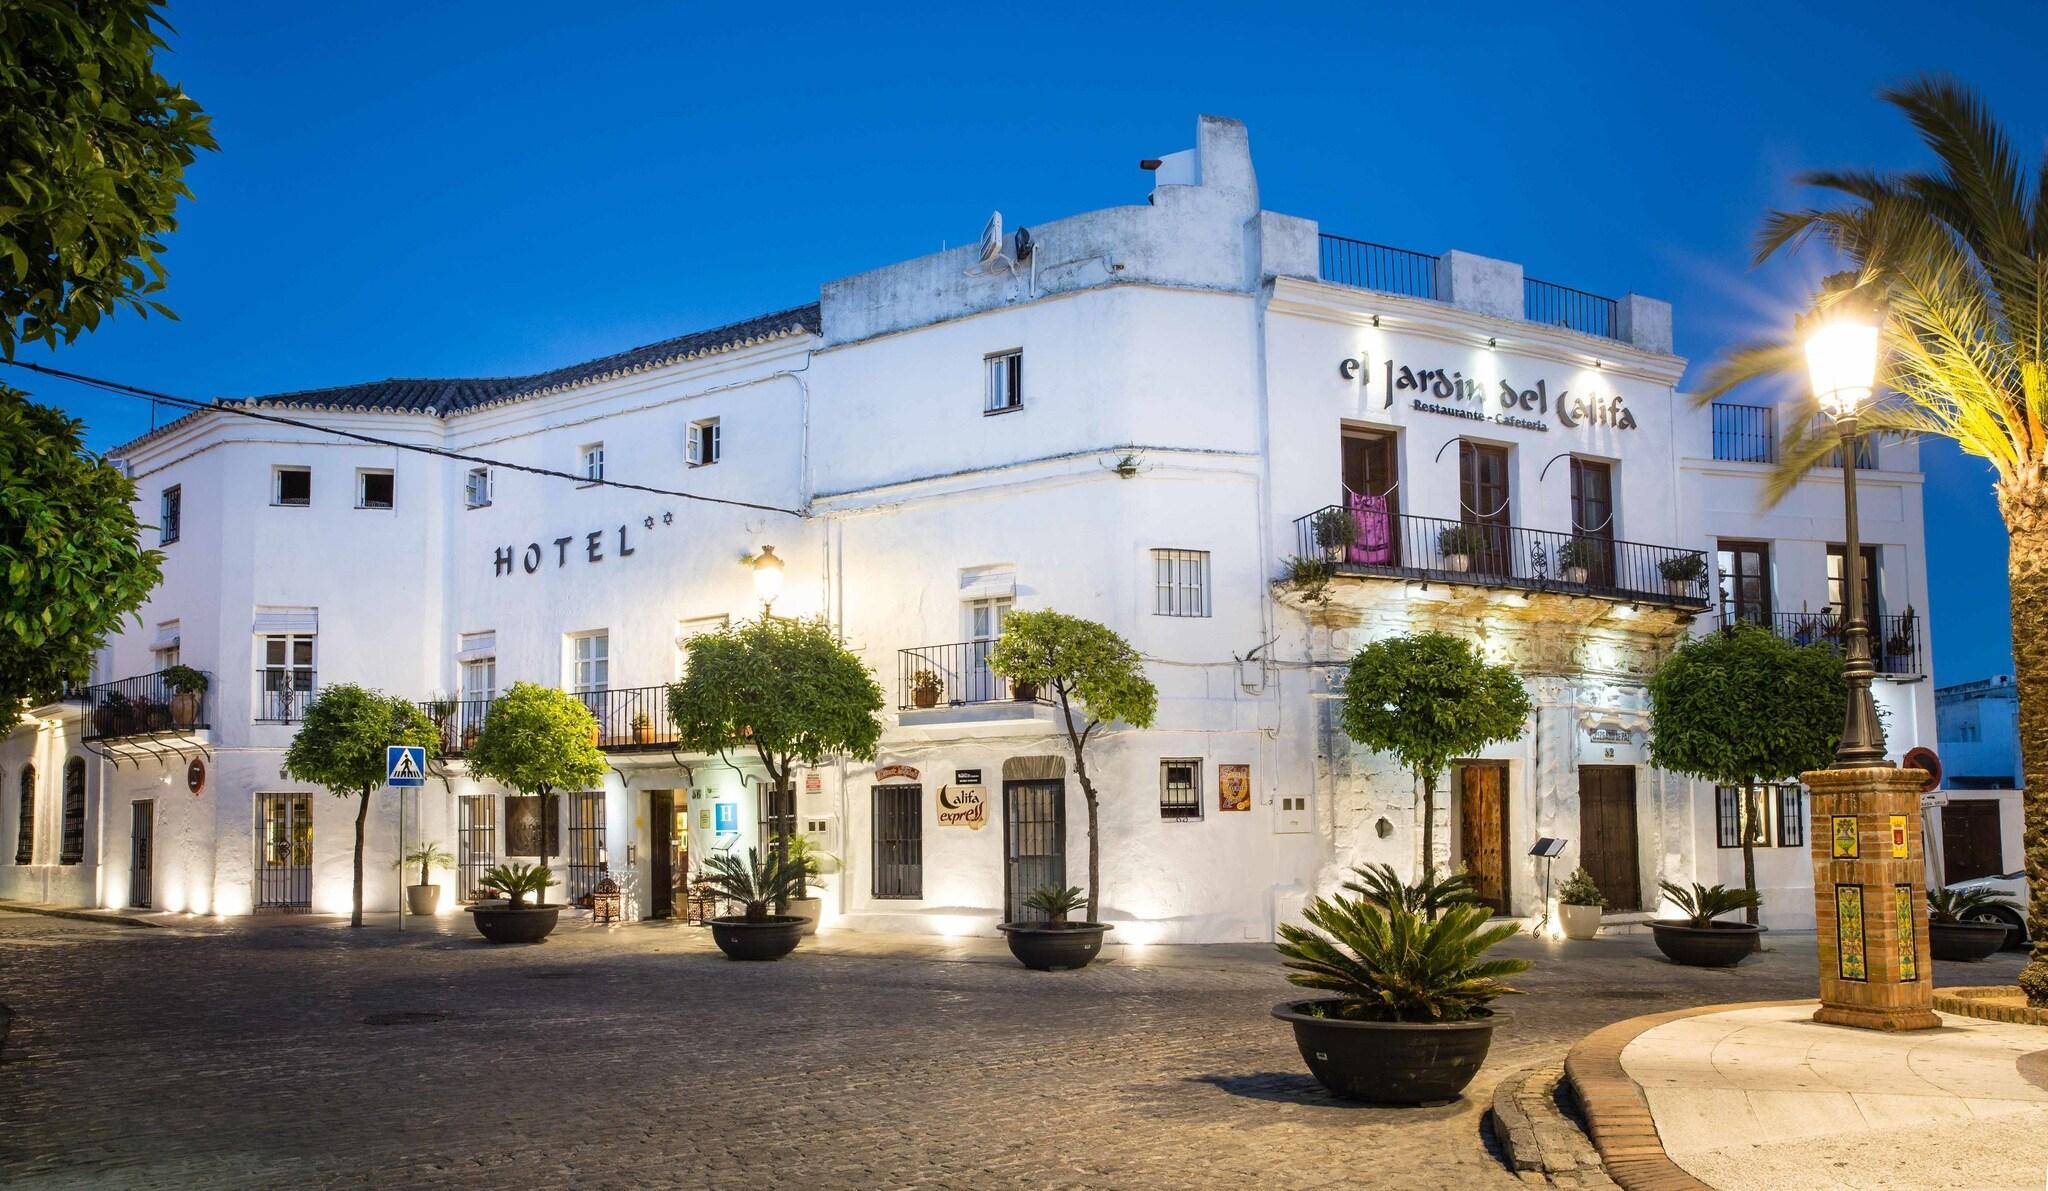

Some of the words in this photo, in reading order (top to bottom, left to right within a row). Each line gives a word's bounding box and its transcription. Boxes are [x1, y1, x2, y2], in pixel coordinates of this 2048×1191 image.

[1339, 350, 1370, 385] el
[1499, 379, 1548, 415] del
[1556, 390, 1638, 430] Califa
[1412, 399, 1485, 421] Restaurante
[493, 524, 635, 578] HOTEL
[940, 784, 980, 809] Califa
